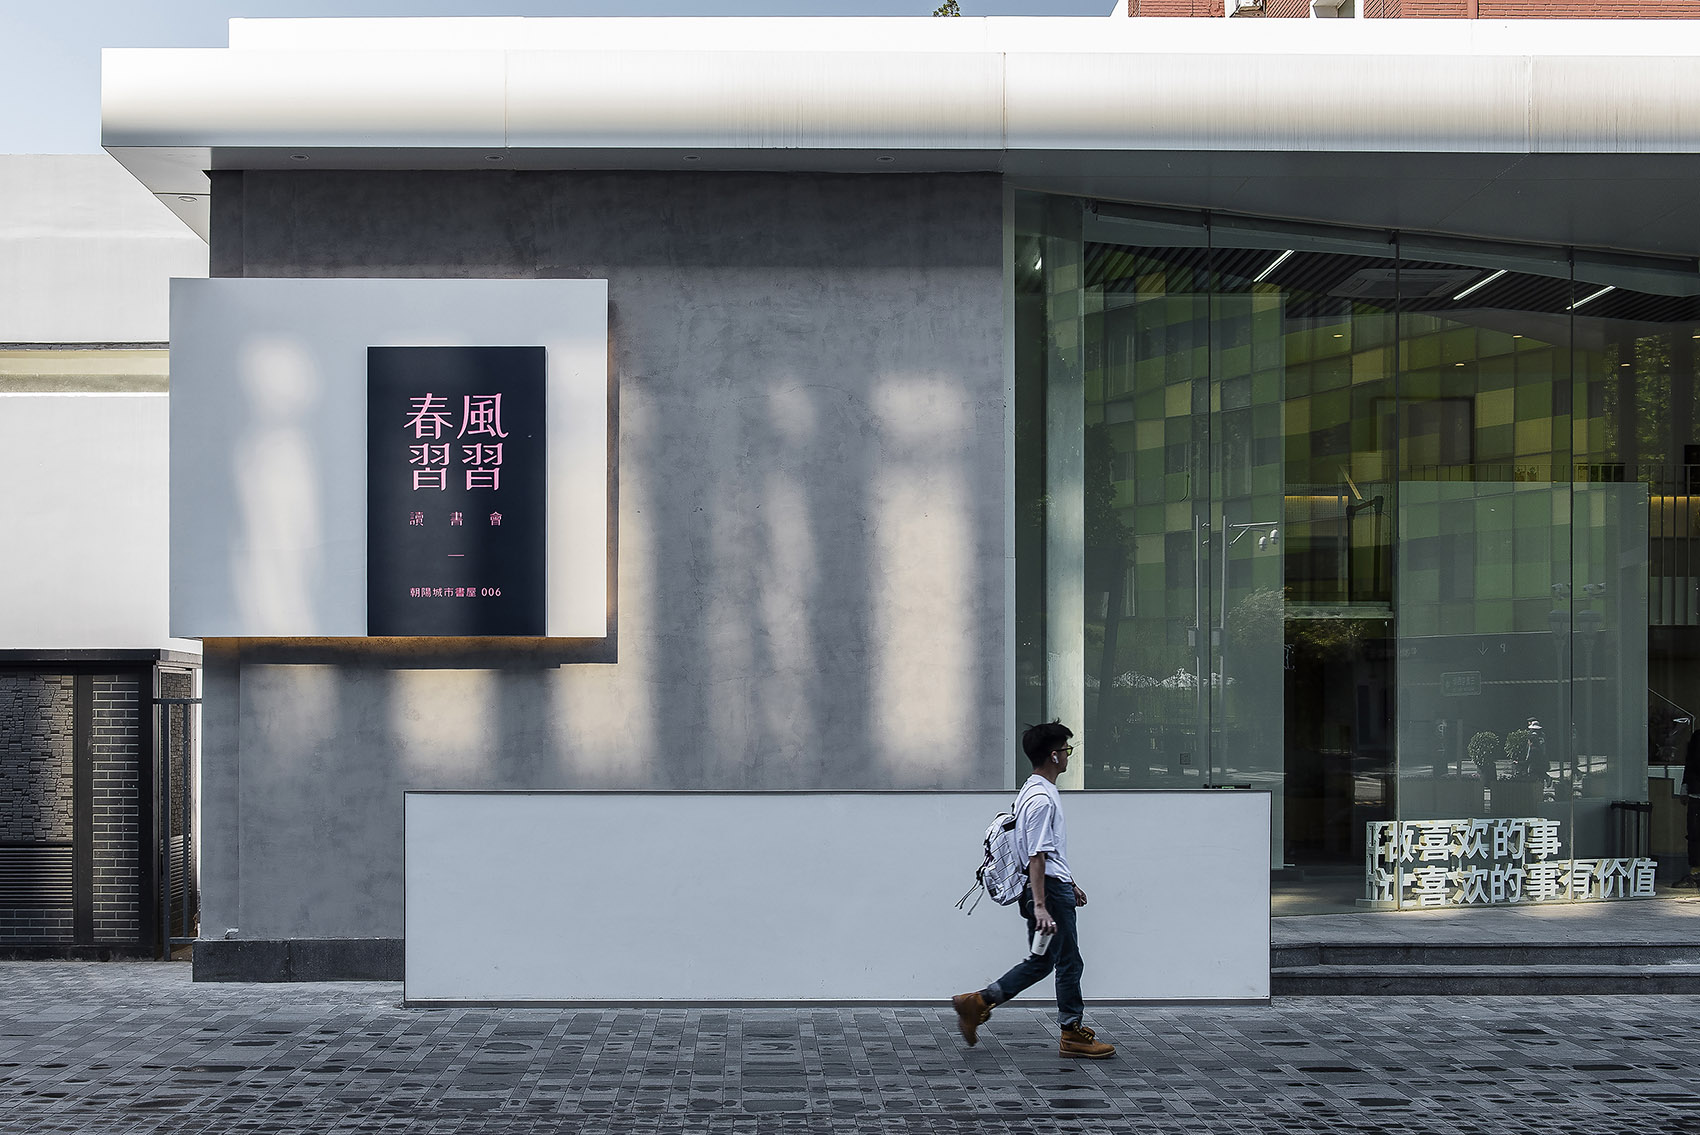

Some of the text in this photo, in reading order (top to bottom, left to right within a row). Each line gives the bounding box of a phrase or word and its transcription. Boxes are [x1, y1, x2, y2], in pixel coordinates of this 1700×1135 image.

[404, 392, 508, 439] 春風
[409, 442, 503, 490] 習習
[410, 587, 501, 597] 朝陽城市書屋 006
[1375, 858, 1658, 906] 让喜欢的事有价值
